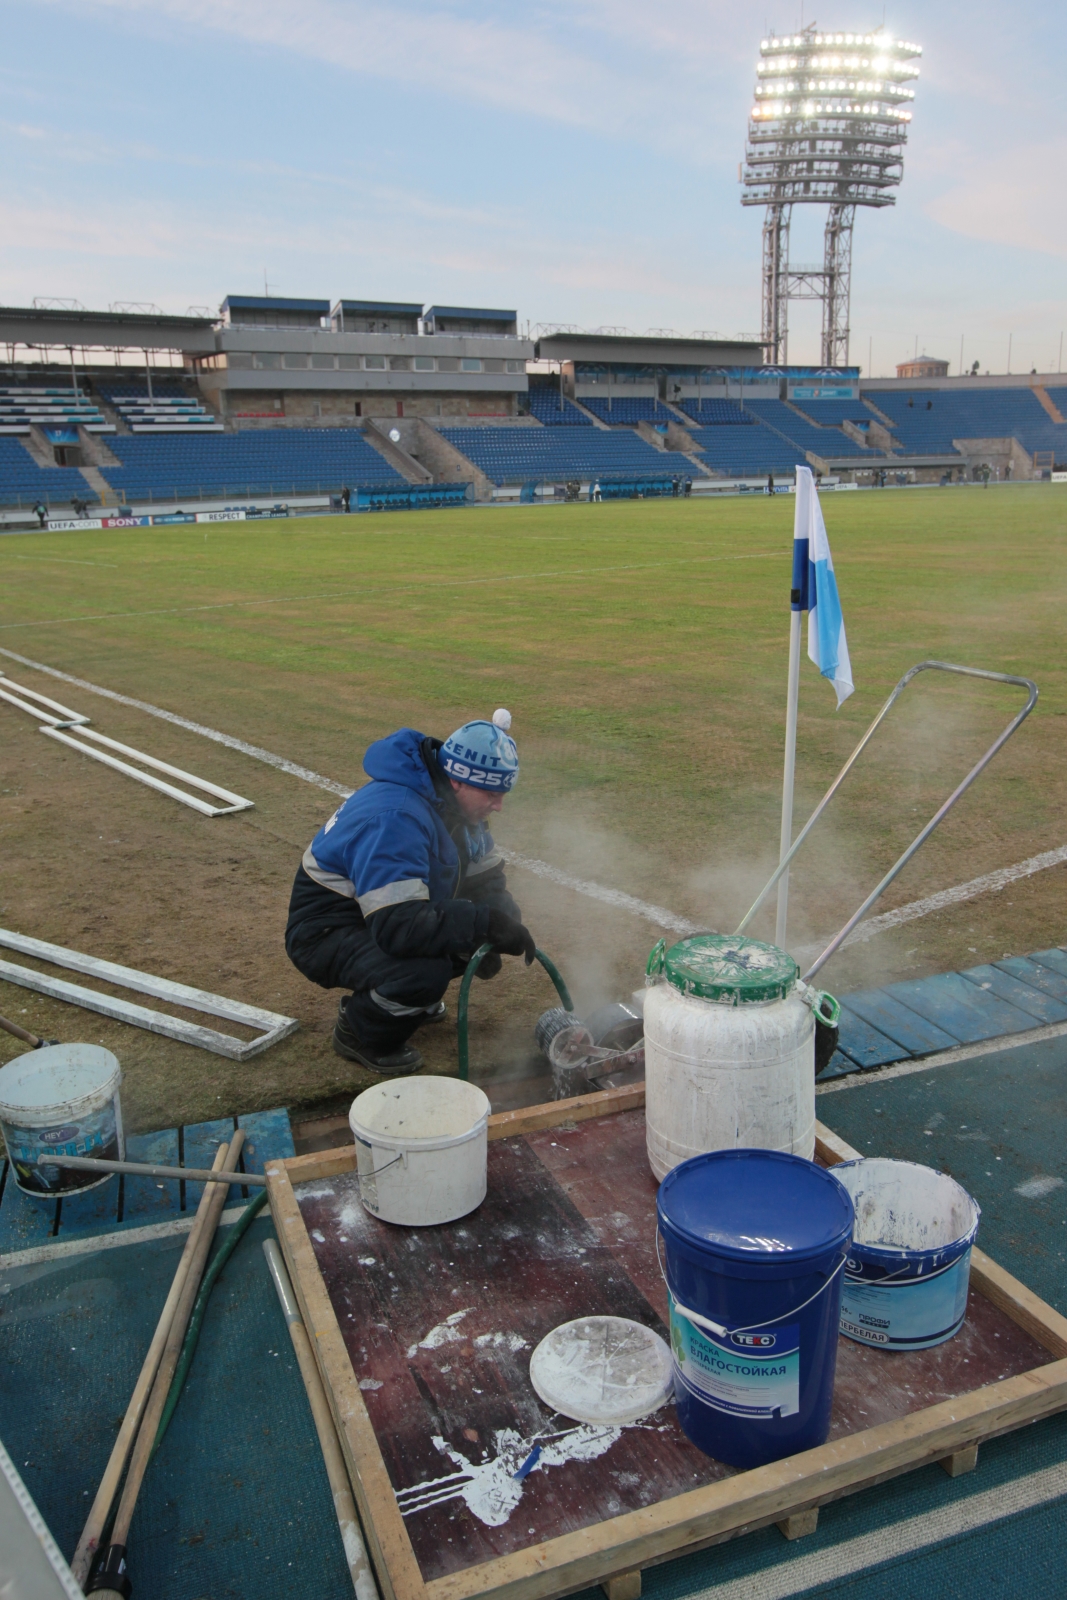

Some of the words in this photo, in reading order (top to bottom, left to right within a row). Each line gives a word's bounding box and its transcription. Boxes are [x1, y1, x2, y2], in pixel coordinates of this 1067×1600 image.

[107, 518, 142, 528] SONY
[208, 512, 241, 521] RESPECT
[445, 738, 502, 768] ZENIT
[443, 758, 503, 786] 1925
[858, 1313, 891, 1326] ПРОФИ
[690, 1336, 720, 1357] КРАСКА
[736, 1335, 770, 1345] ТЕКС
[690, 1345, 787, 1377] ВЛАГОСТОЙКАЯ
